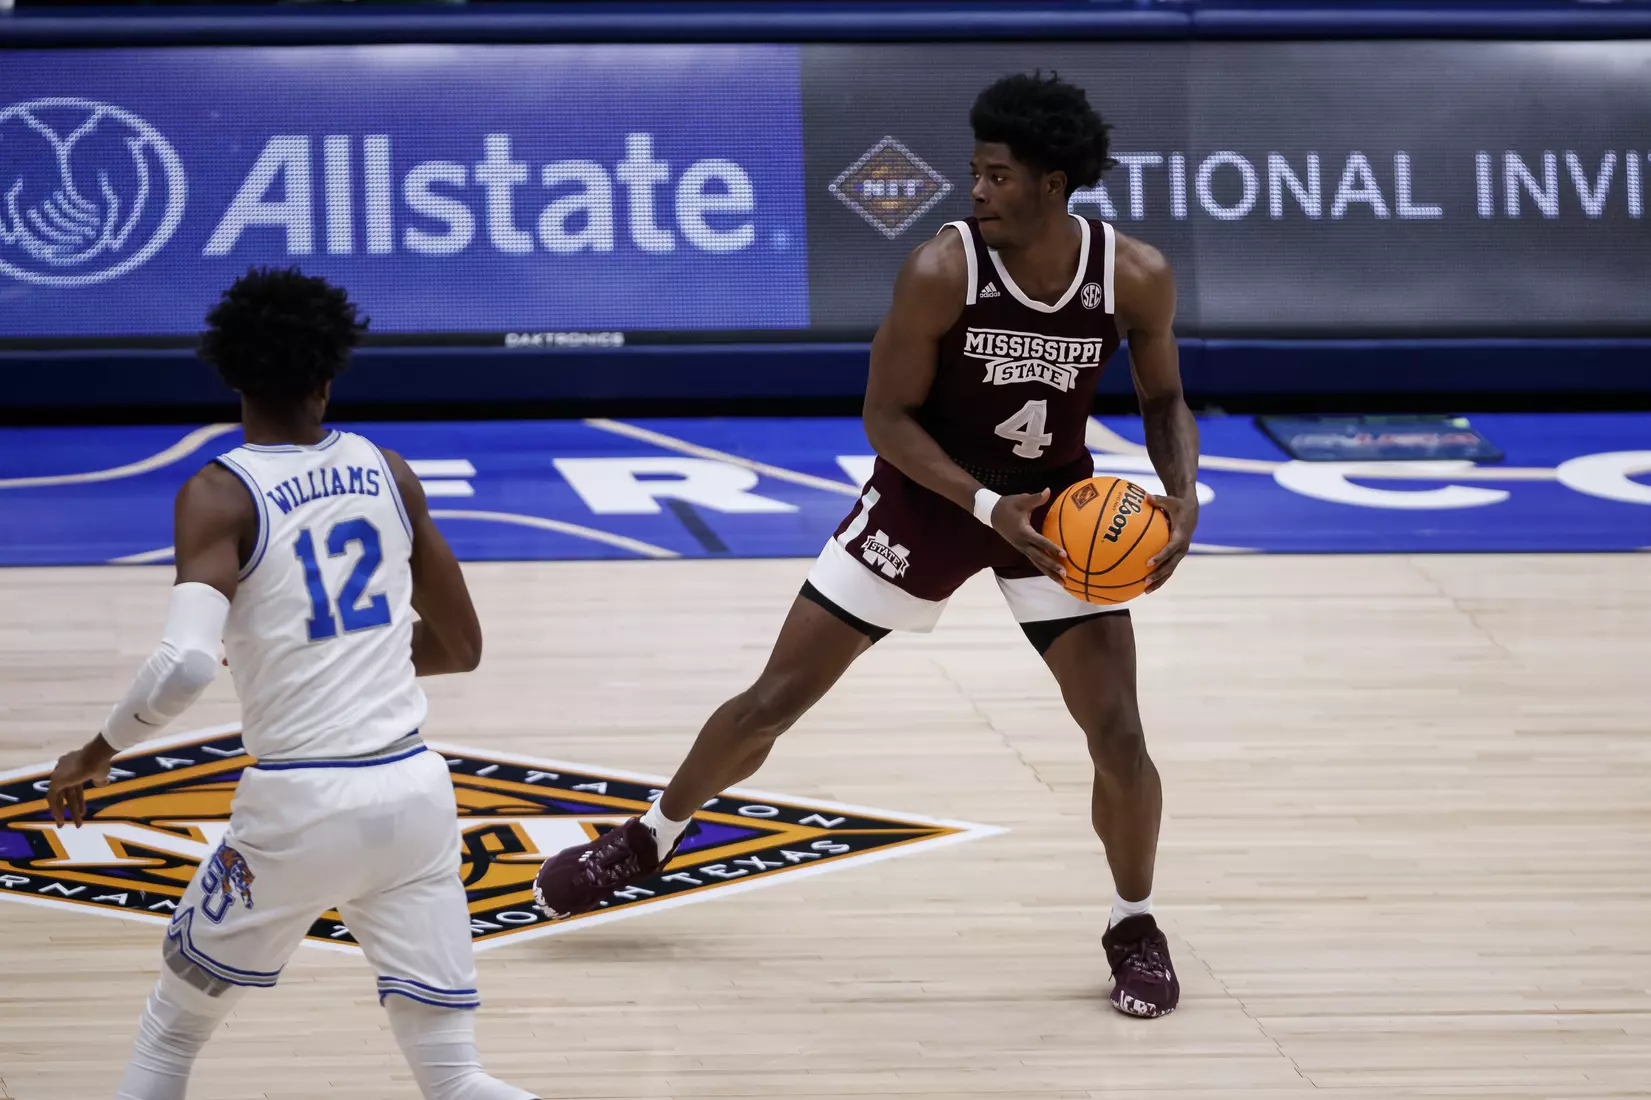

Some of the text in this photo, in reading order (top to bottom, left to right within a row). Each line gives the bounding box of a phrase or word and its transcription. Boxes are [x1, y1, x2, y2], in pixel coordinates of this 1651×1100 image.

[201, 133, 756, 255] Allstate
[1067, 150, 1651, 220] ATIONAL INVI
[979, 290, 1001, 299] adidas
[1083, 284, 1101, 308] SEC
[963, 332, 1103, 363] MISSISSIPPI
[1000, 363, 1064, 387] STATE
[994, 399, 1053, 460] 4
[266, 465, 380, 515] WILLIAMS
[1103, 482, 1146, 543] Wilson
[292, 514, 393, 642] 12
[869, 541, 901, 568] STATE
[660, 839, 851, 885] TEXAS
